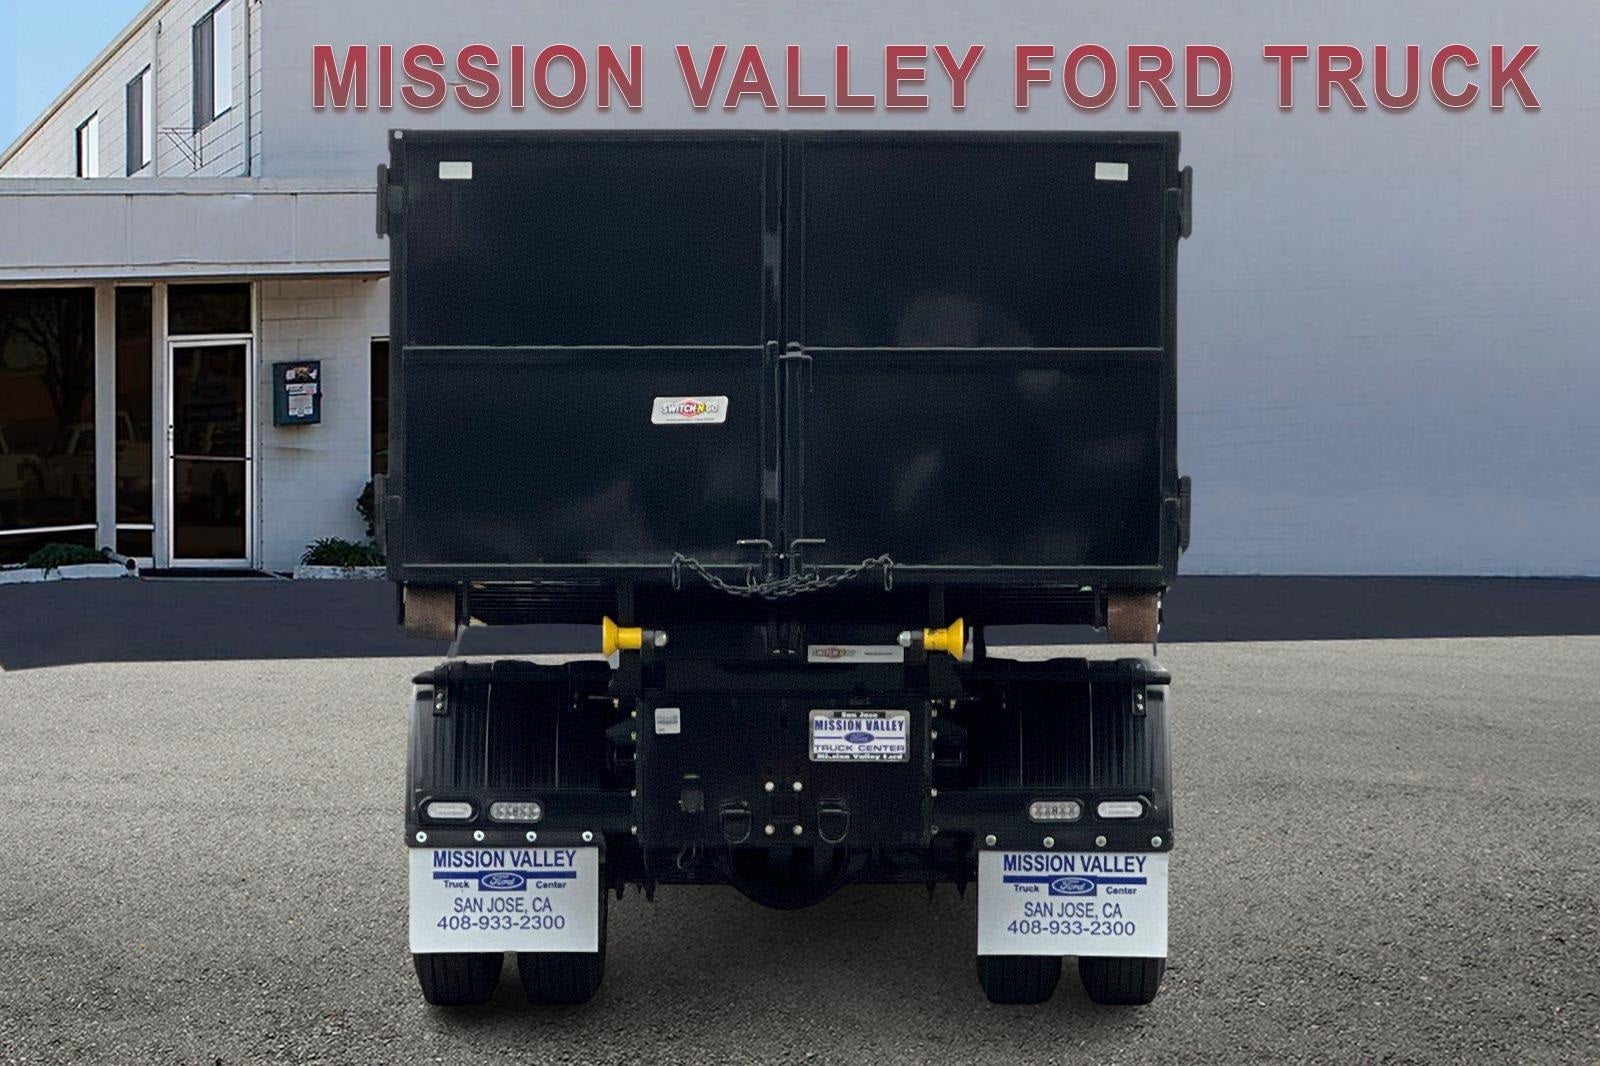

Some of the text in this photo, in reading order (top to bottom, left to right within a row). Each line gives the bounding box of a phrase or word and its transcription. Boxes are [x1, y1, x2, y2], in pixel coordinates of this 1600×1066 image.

[814, 719, 904, 731] MISSION VALLEY
[814, 744, 905, 752] TRUCK CENTER
[433, 850, 576, 868] MISSION VALLEY
[1003, 854, 1147, 873] MISSION VALLEY
[443, 874, 567, 889] Truck Ford Center
[1014, 879, 1138, 895] Truck Ford Center
[453, 897, 552, 915] SAN JOSE, CA
[1024, 901, 1122, 919] SAN JOSE, CA
[436, 915, 565, 931] 408-933-2300
[1007, 920, 1136, 936] 408-933-2300
